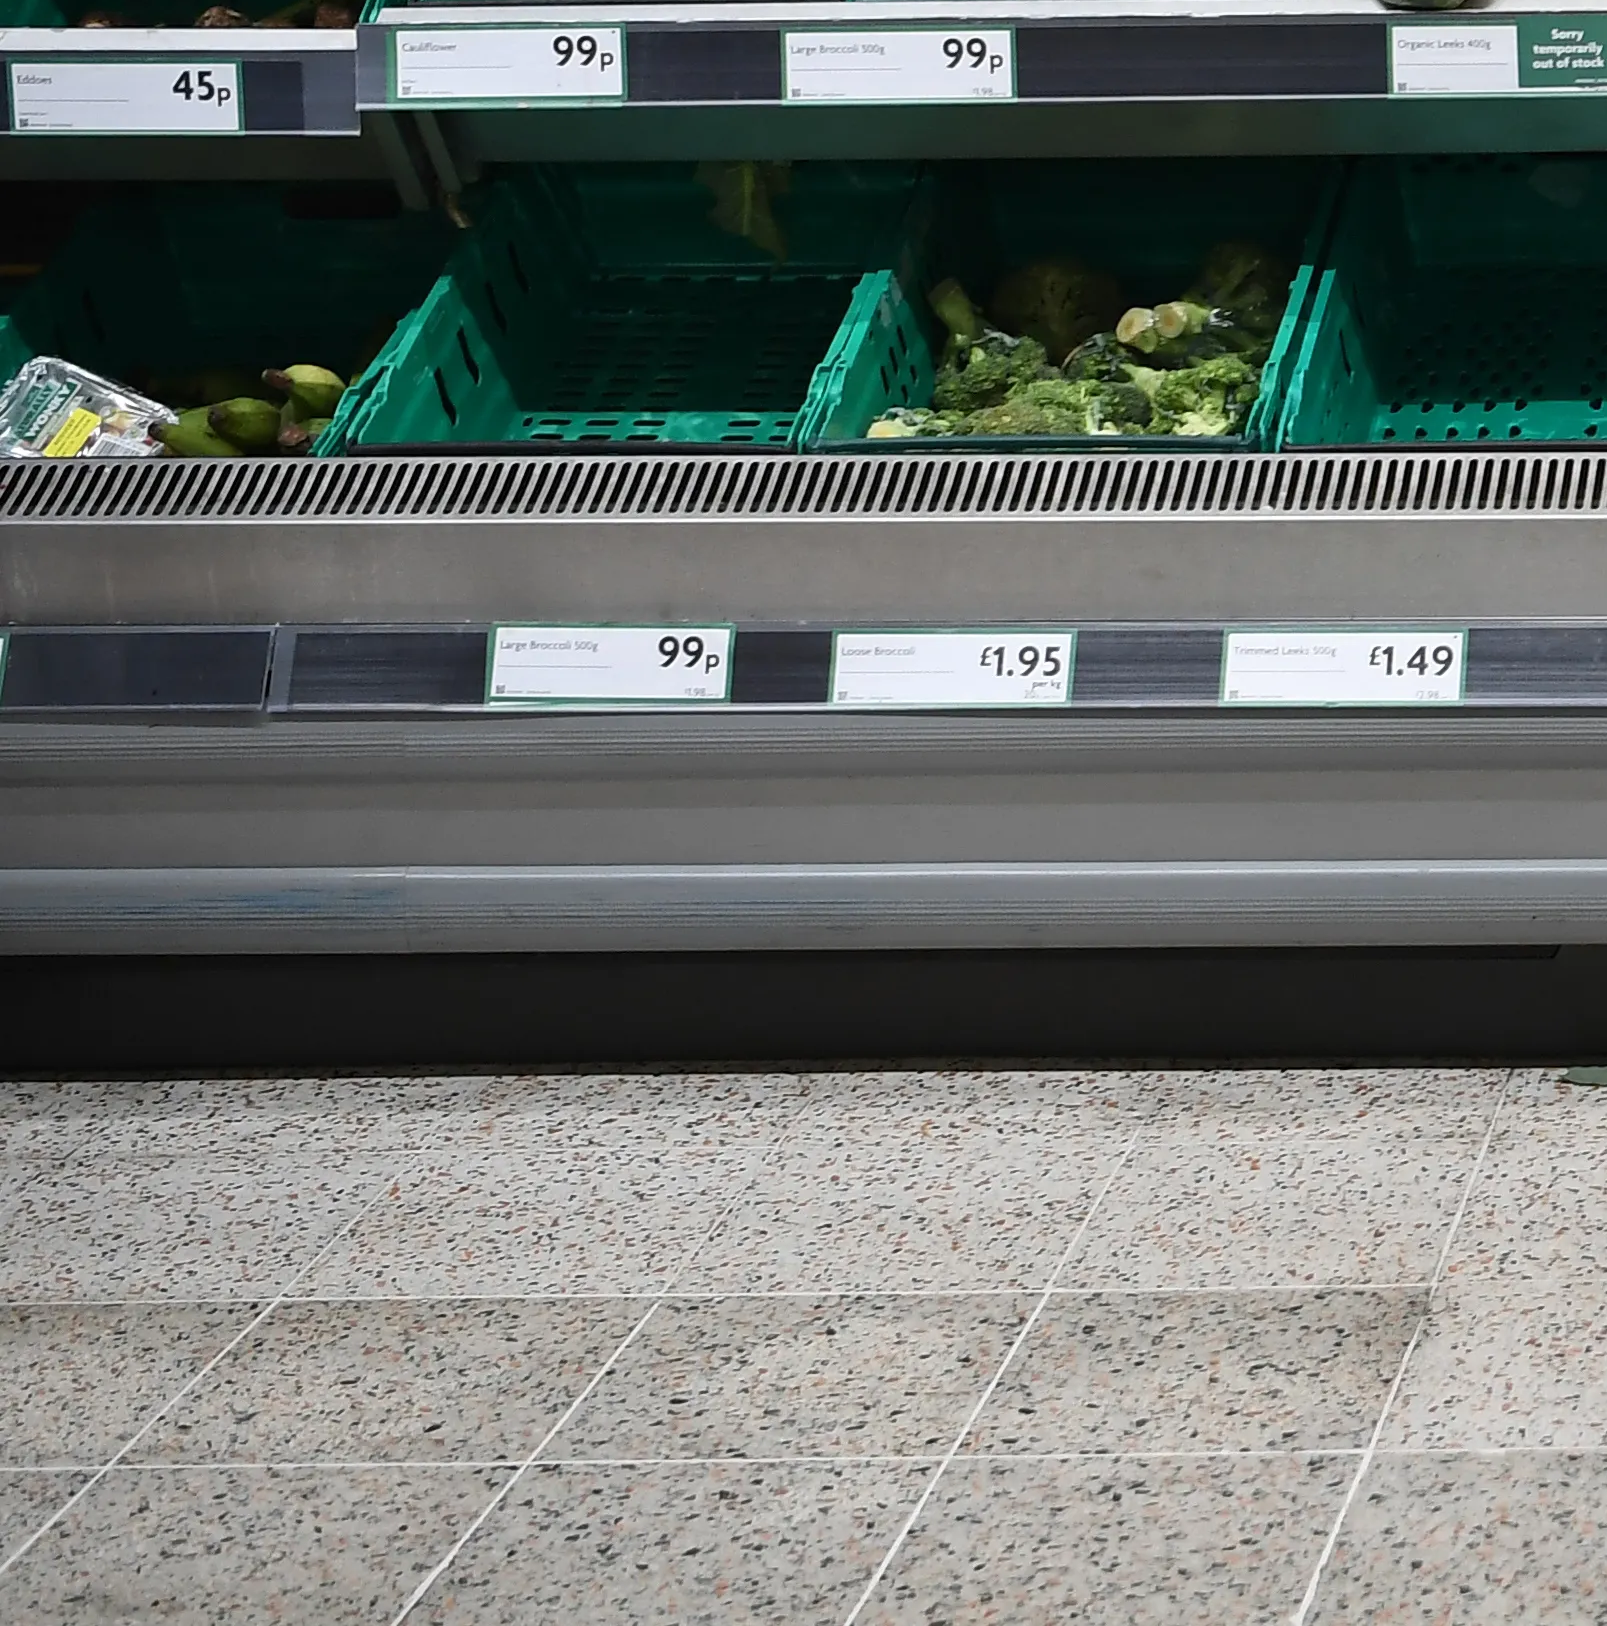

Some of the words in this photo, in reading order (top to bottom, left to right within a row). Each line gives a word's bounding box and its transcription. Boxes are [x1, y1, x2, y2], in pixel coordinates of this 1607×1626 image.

[1551, 28, 1585, 43] Sorry
[402, 41, 457, 53] Cauliflower
[553, 31, 613, 71] 99p
[790, 45, 816, 58] Large
[818, 44, 860, 56] Broccoli
[1397, 39, 1435, 52] Organic
[1436, 38, 1465, 50] Leeks
[1466, 39, 1493, 53] 400g
[1532, 42, 1603, 58] temporarily
[943, 38, 1003, 74] 99p
[1532, 59, 1554, 70] out
[1556, 57, 1571, 69] of
[1572, 56, 1605, 69] stock
[16, 74, 53, 86] Eddoes
[173, 71, 230, 106] 45p
[500, 641, 528, 654] Large
[529, 640, 572, 652] Broccoli
[841, 646, 872, 657] Loose
[874, 646, 916, 657] Broccoli
[1233, 645, 1277, 657] Trimmed
[1279, 645, 1309, 657] Leeks
[659, 636, 719, 674] 99p
[980, 646, 1060, 676] £1.95
[1370, 646, 1453, 676] £1.49
[1031, 681, 1049, 692] per
[1050, 679, 1062, 691] kg
